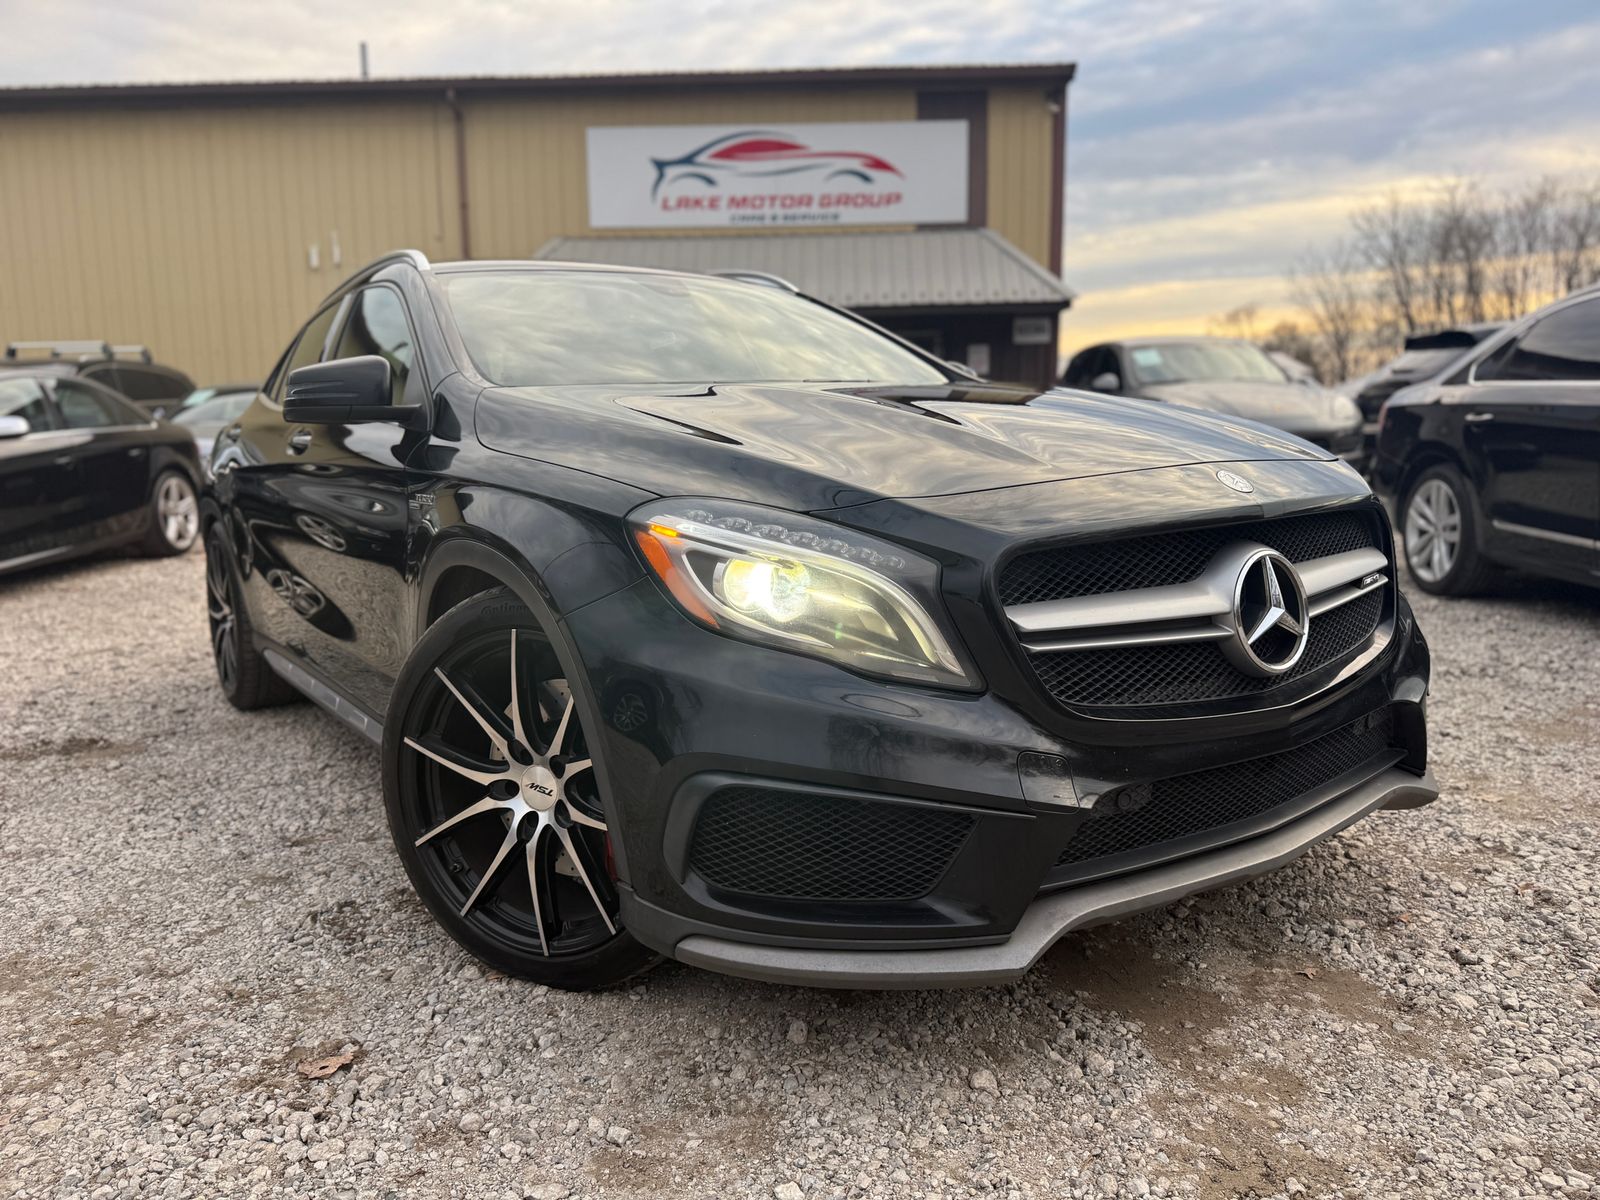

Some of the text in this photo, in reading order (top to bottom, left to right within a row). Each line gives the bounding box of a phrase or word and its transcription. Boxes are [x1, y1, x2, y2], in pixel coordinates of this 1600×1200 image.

[661, 191, 903, 212] LAKE MOTOR GROUP
[525, 782, 554, 797] TSW
